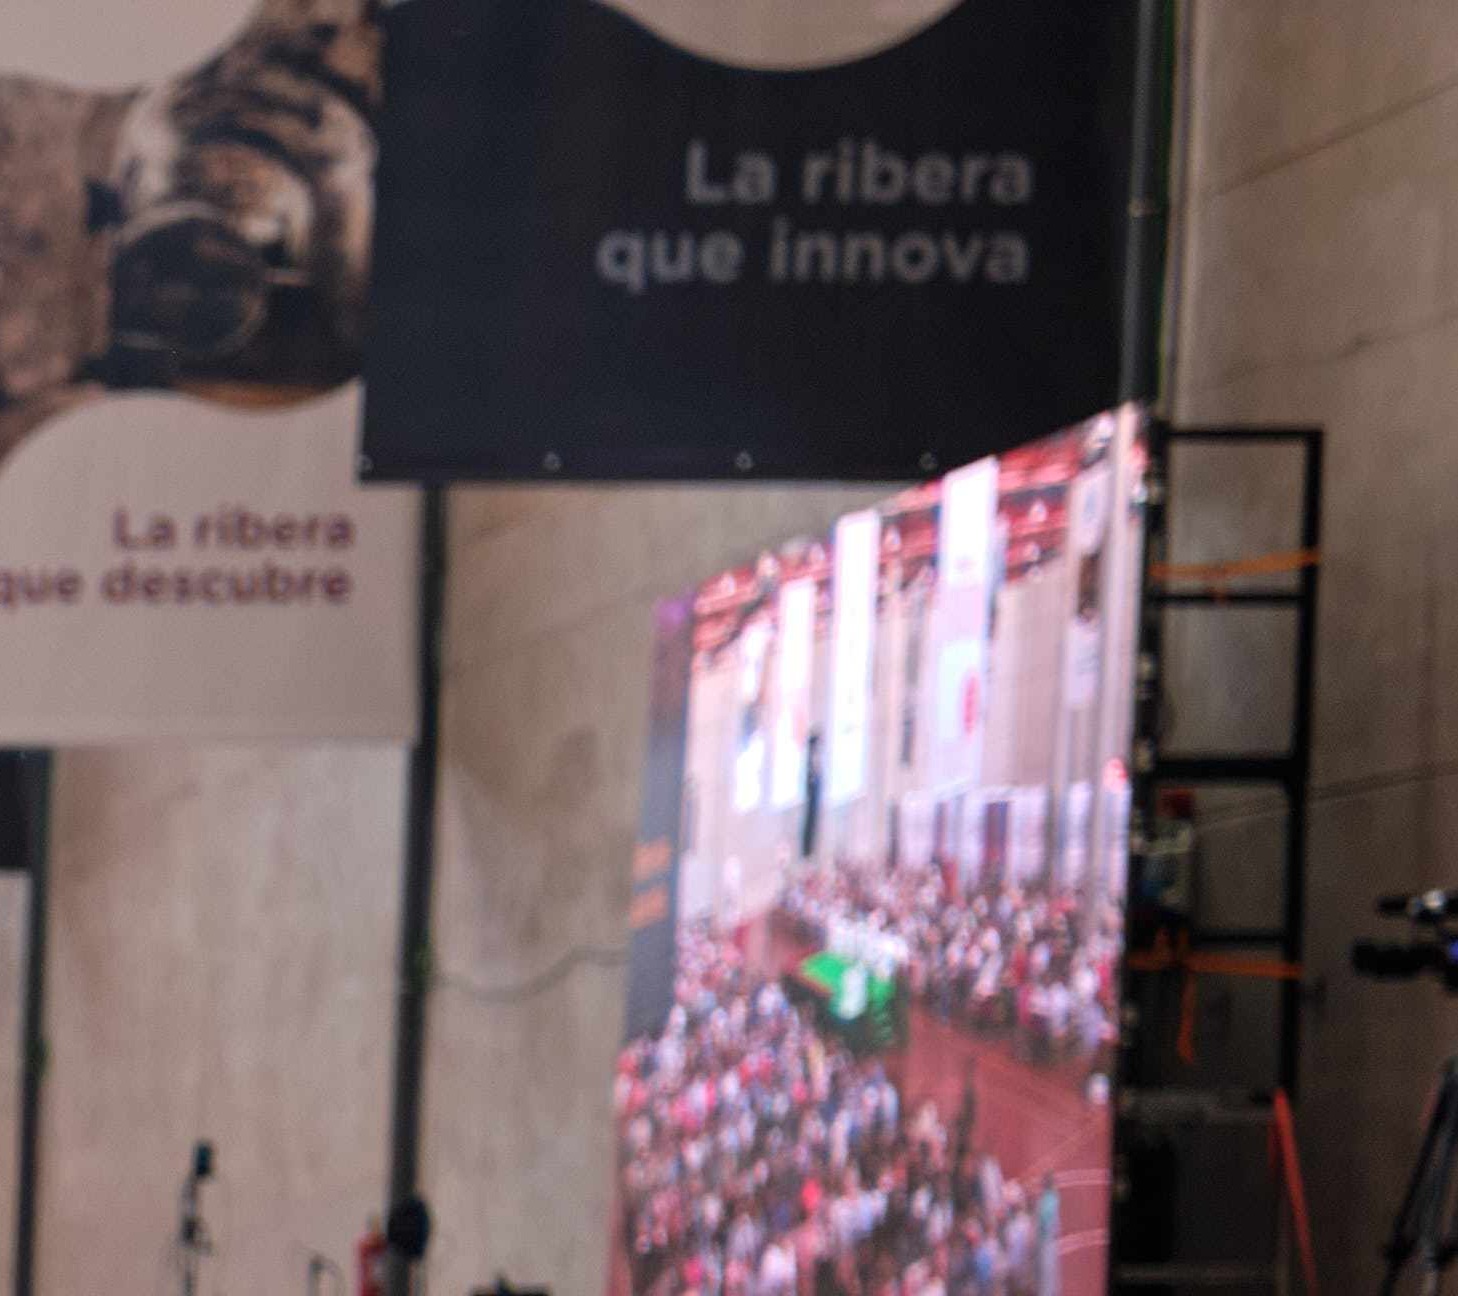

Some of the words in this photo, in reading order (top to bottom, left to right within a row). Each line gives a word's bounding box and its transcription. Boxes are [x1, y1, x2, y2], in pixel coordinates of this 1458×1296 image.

[685, 138, 776, 204] La
[802, 137, 1034, 204] ribera
[596, 229, 744, 295] que
[769, 216, 1029, 284] innova
[112, 506, 177, 552] La
[192, 506, 356, 552] ribera
[101, 560, 354, 603] descubre
